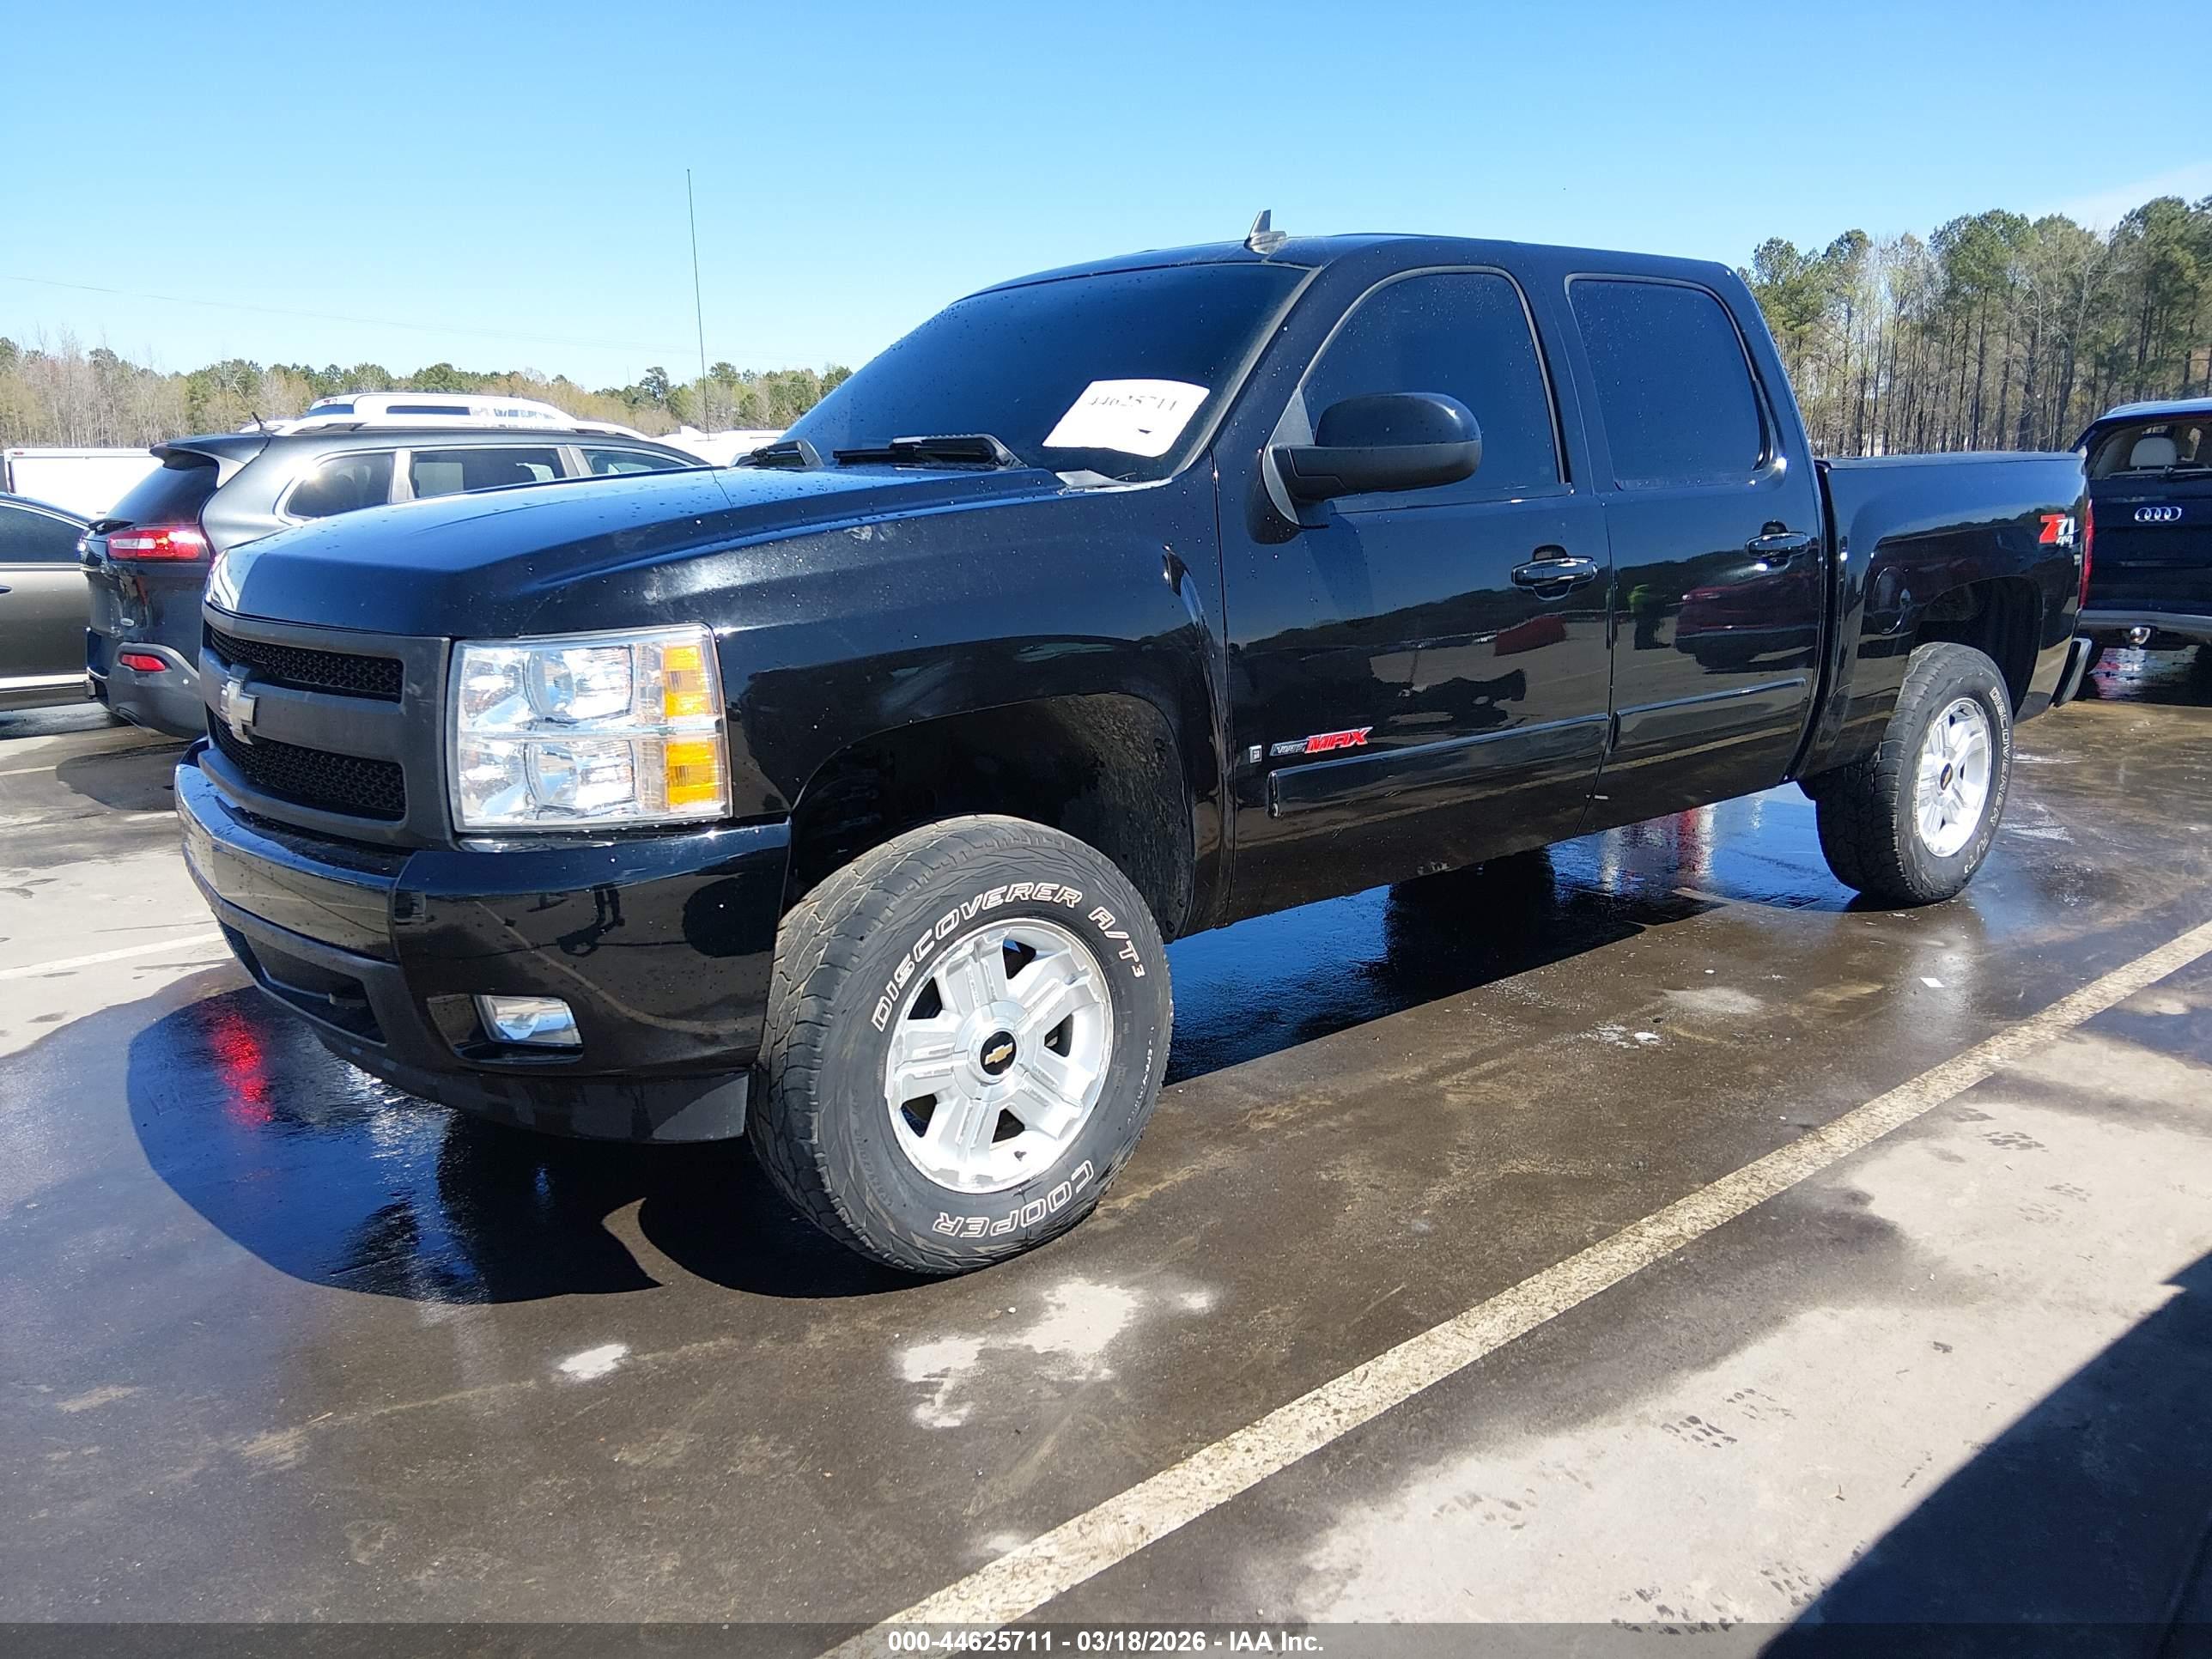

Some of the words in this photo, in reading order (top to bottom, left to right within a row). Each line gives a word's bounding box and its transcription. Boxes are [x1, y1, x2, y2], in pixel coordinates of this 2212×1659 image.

[2039, 514, 2075, 544] Z71
[1304, 726, 1374, 754] MAX
[1989, 686, 2010, 827] DISCOVERER
[870, 882, 1083, 1032] DISCOVERER
[932, 1159, 1094, 1238] COOPER
